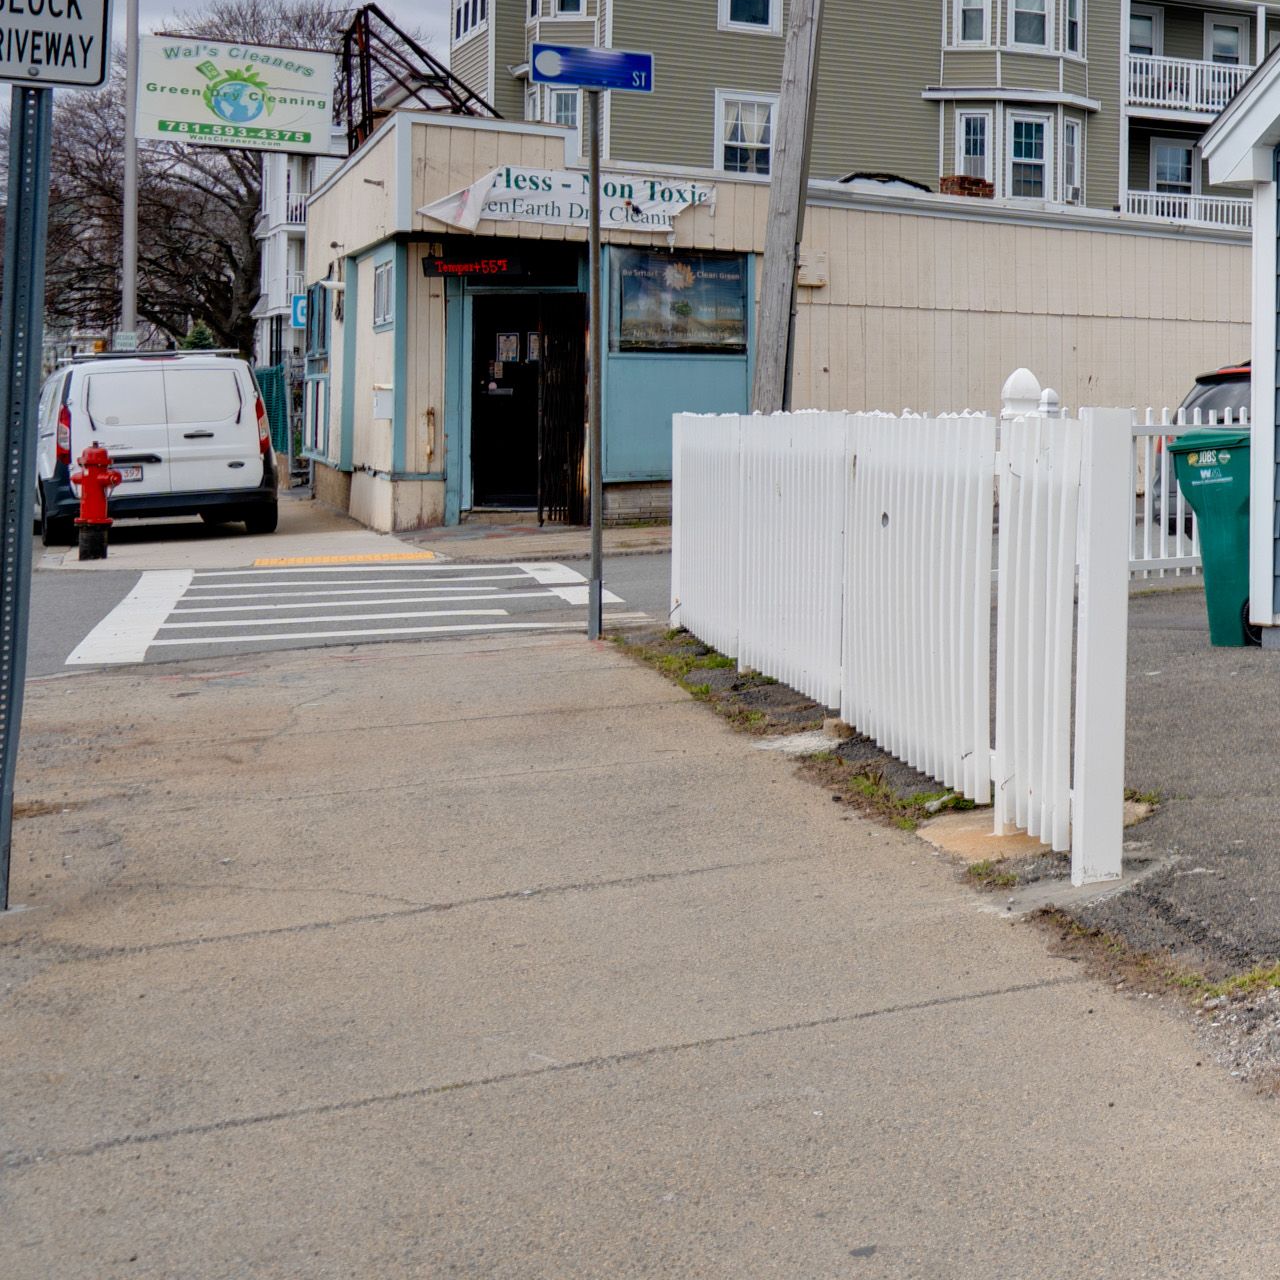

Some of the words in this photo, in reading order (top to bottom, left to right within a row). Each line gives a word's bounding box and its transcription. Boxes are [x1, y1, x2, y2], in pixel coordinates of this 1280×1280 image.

[0, 26, 93, 69] IVEWAY
[163, 45, 219, 60] Wal's
[228, 47, 315, 77] Cleaners
[632, 71, 646, 87] ST
[146, 82, 201, 96] Green
[210, 89, 240, 102] Dry
[248, 89, 327, 109] Cleaning
[165, 121, 304, 141] 781-593-4375
[189, 134, 281, 147] WalsCleaners.com
[643, 179, 707, 206] Toxic
[569, 202, 602, 221] Dr
[696, 270, 717, 278] Clean
[1199, 450, 1217, 463] JOBS
